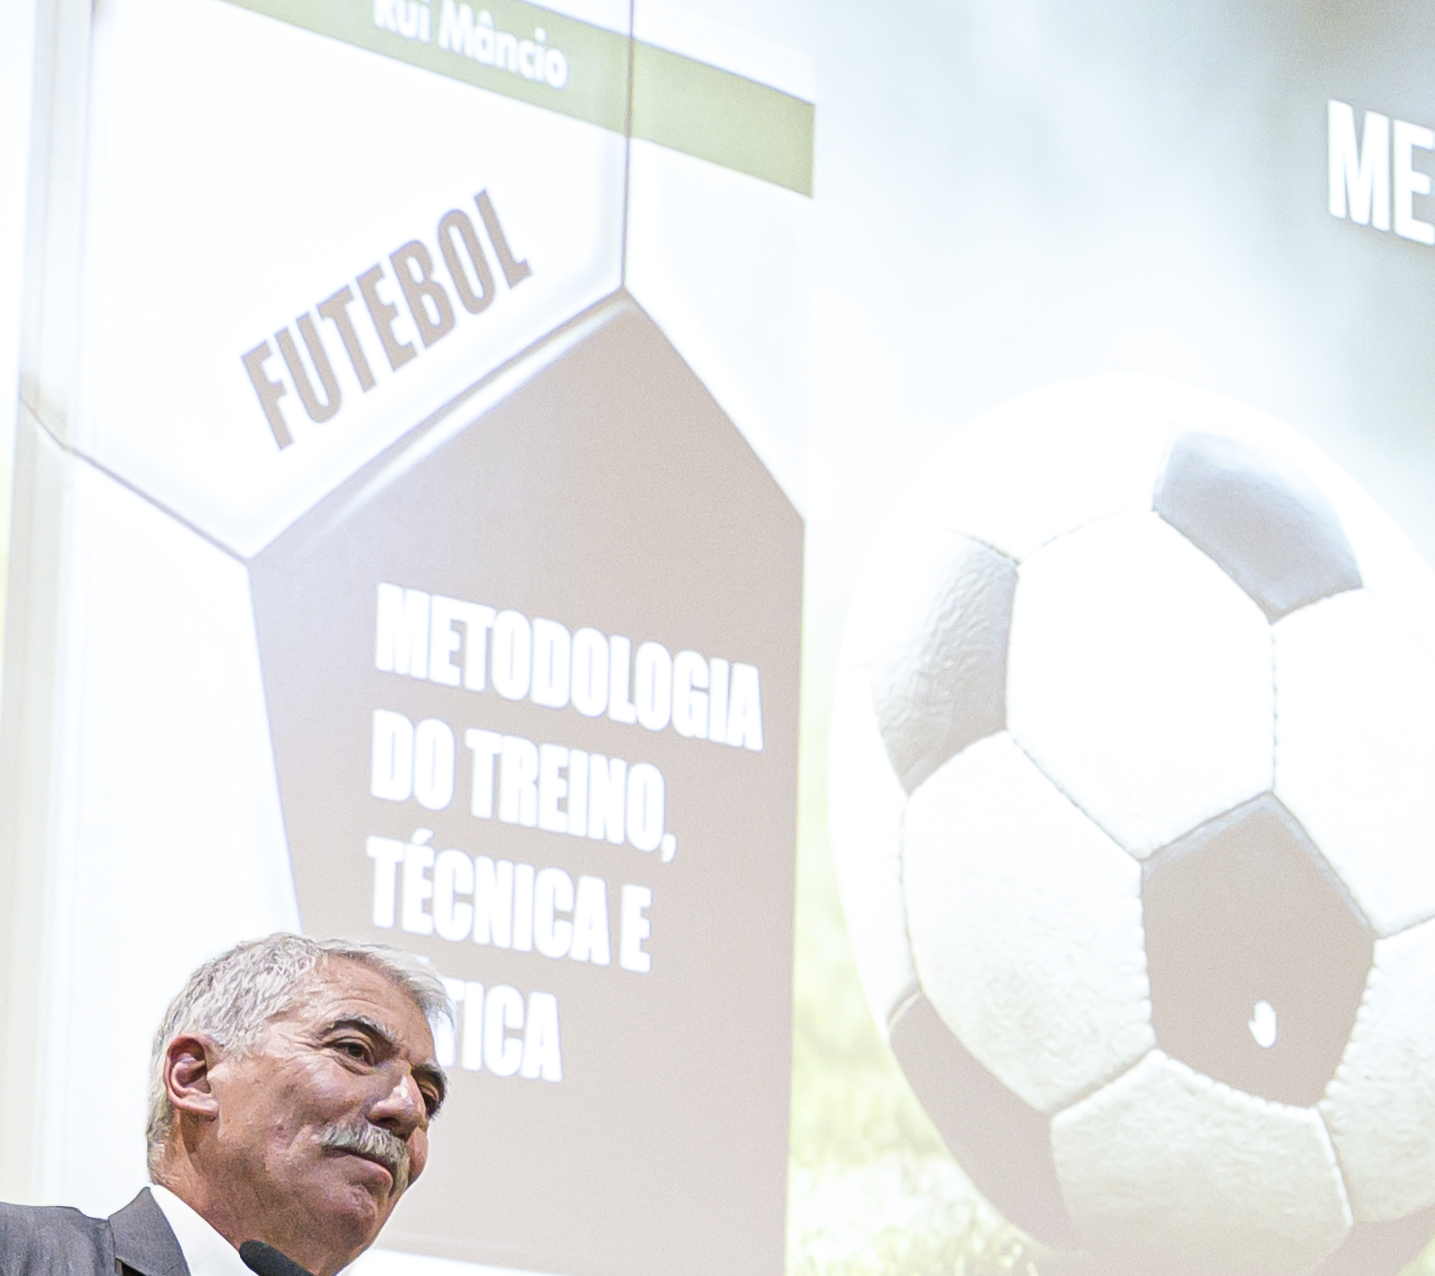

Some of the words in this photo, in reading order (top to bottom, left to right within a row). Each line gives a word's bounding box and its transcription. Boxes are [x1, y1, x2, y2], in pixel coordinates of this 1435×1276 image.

[438, 0, 569, 89] Mâncio
[239, 187, 533, 452] FUTEBOL
[375, 582, 765, 754] METODOLOGIA
[371, 708, 457, 812] DO
[466, 727, 677, 863] TREINO,
[365, 827, 611, 967] TÉCNICA
[619, 884, 653, 975] E
